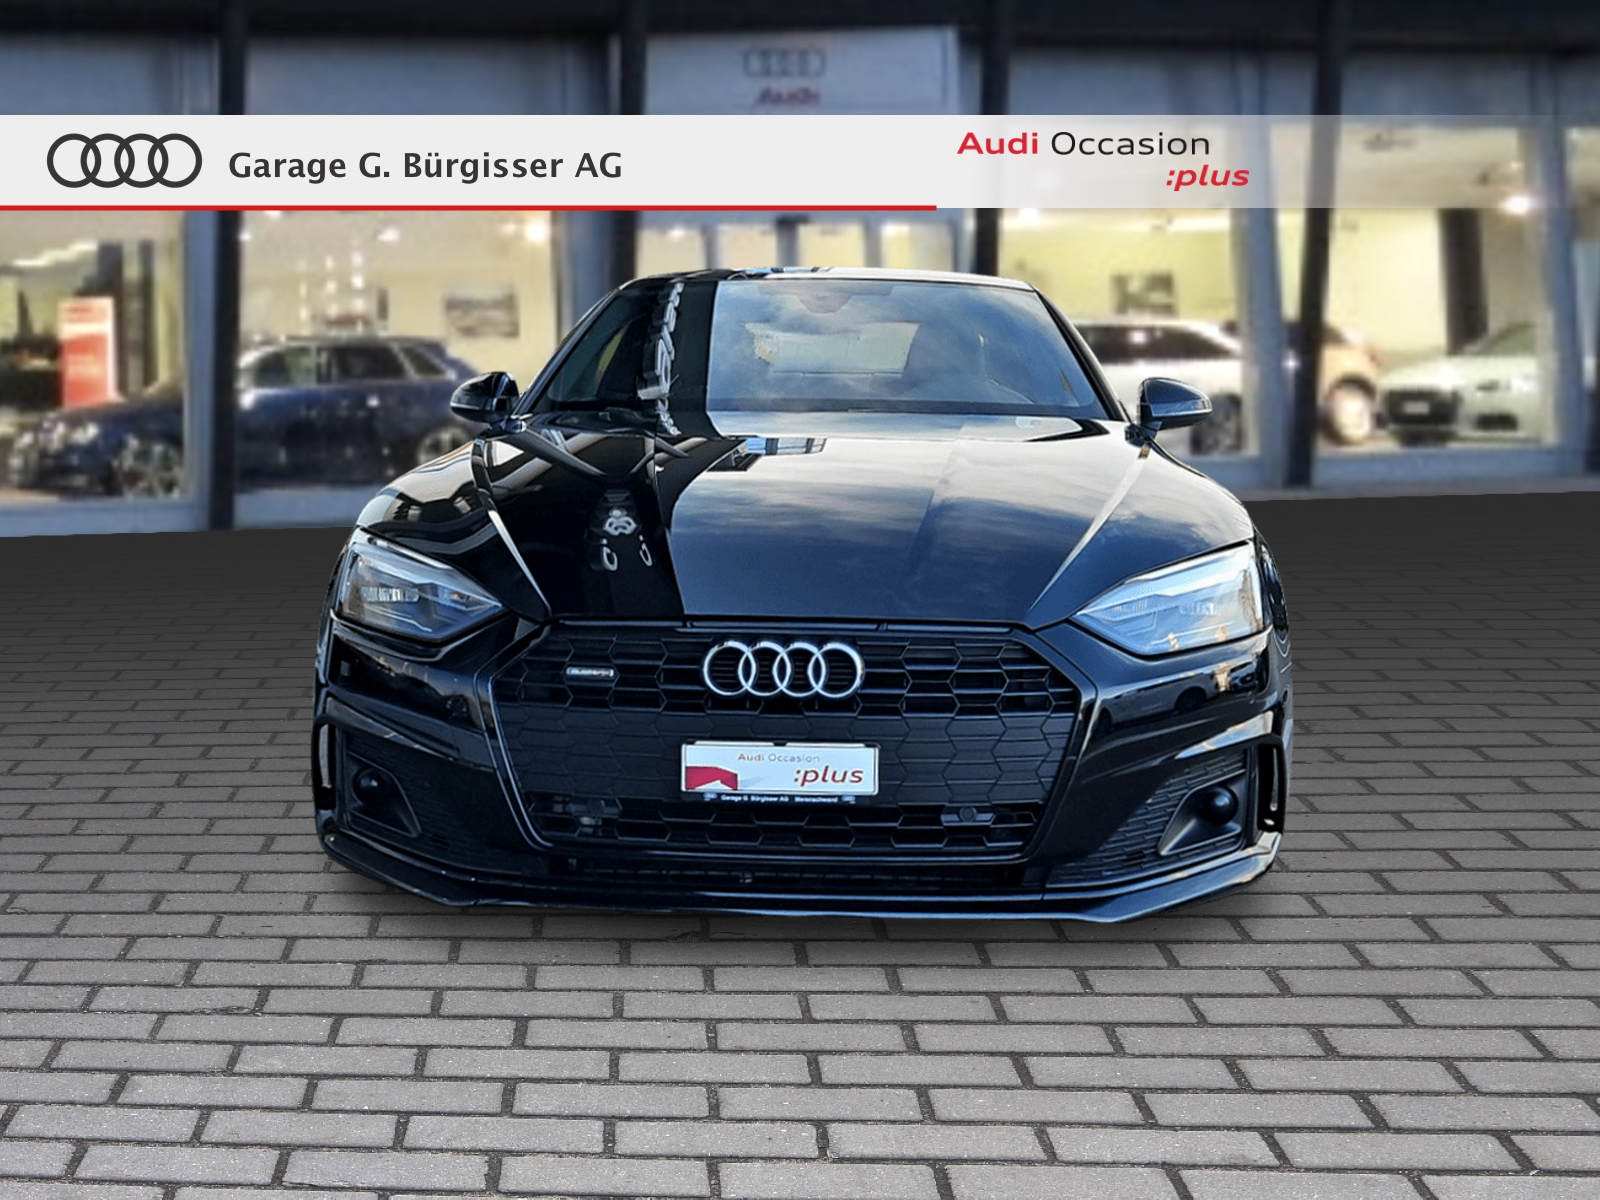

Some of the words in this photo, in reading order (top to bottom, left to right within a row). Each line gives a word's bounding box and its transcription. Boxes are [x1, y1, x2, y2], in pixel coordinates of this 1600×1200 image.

[738, 752, 764, 762] Audi
[768, 752, 820, 763] Occasion
[794, 765, 864, 787] :plus
